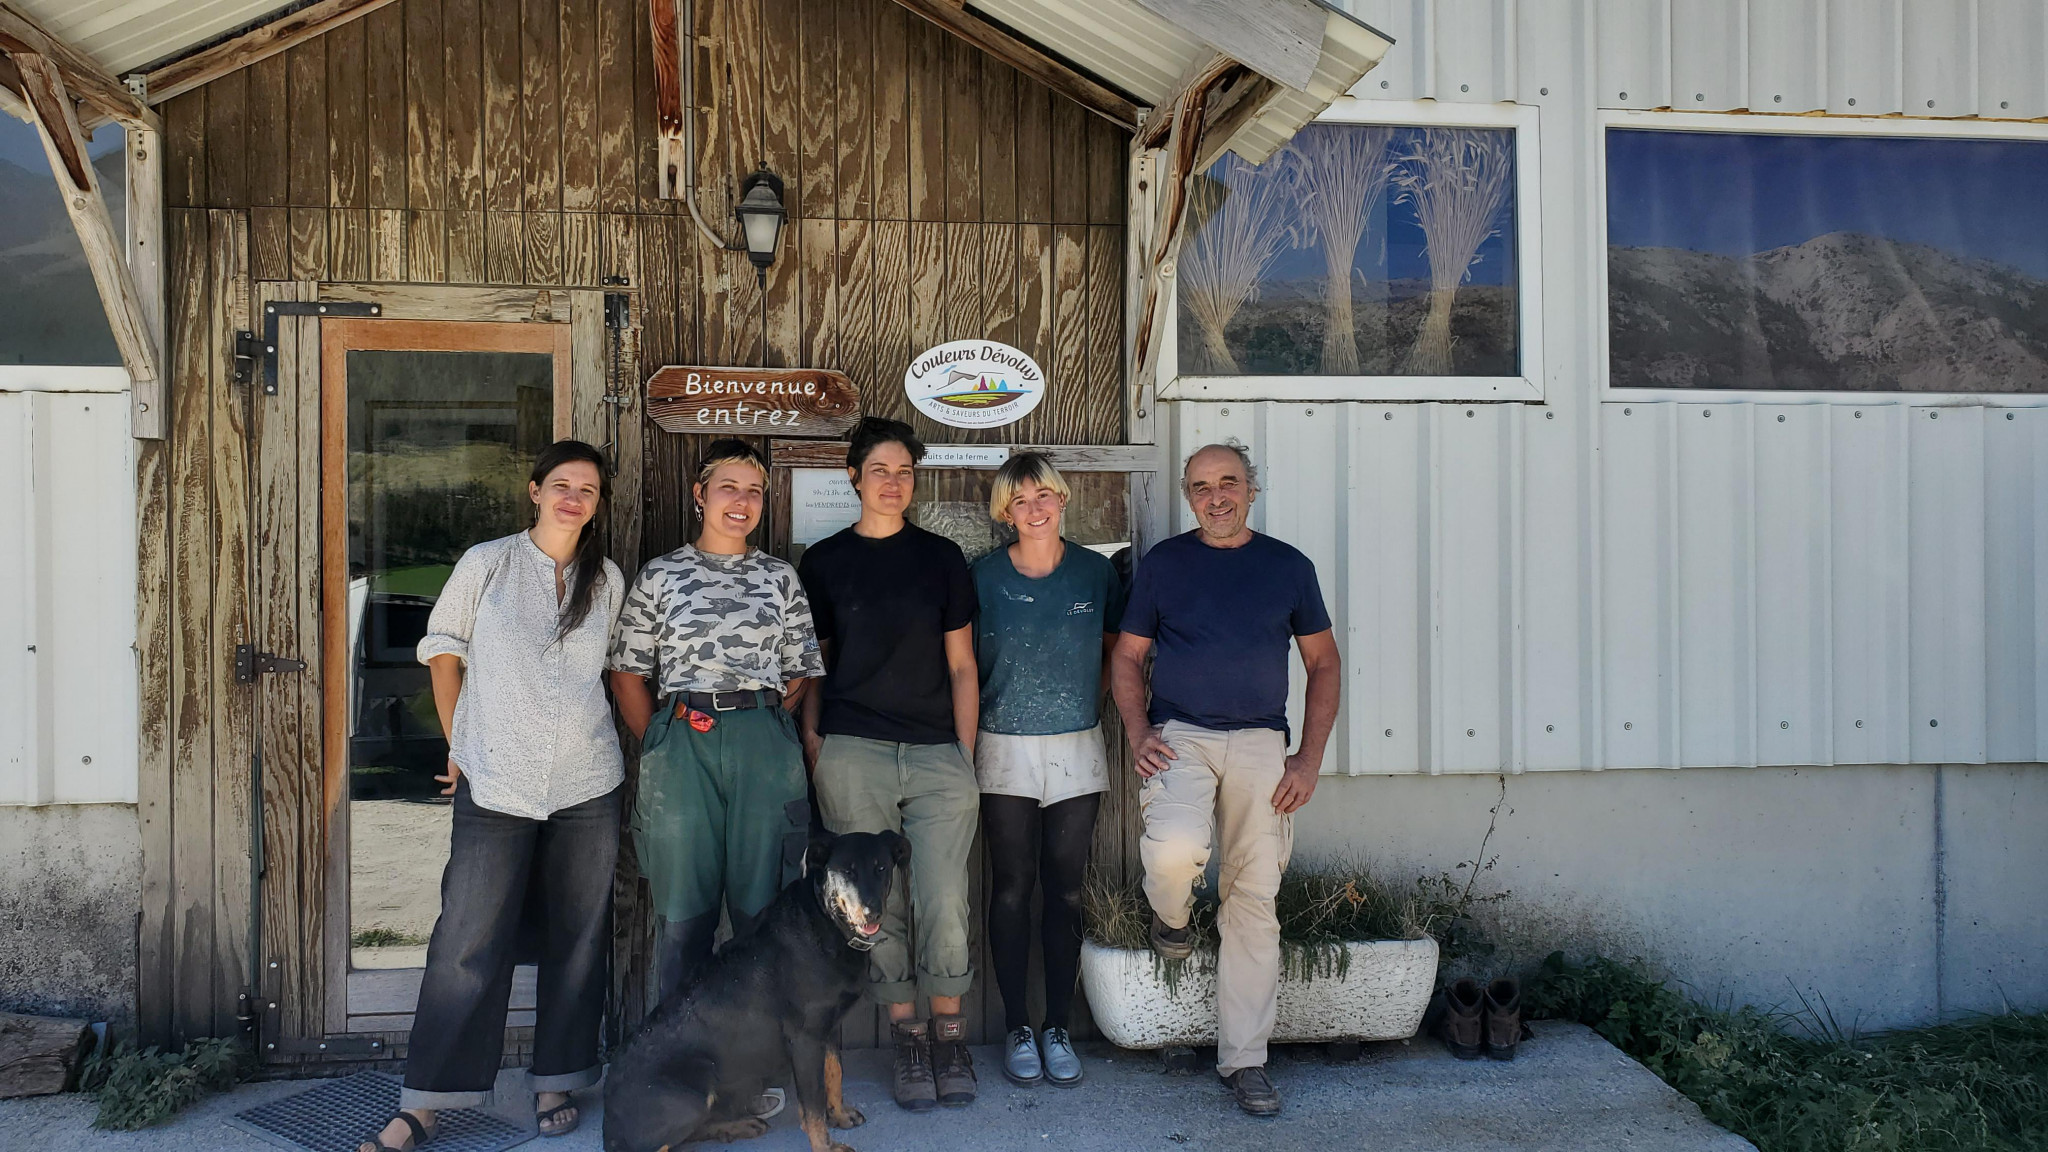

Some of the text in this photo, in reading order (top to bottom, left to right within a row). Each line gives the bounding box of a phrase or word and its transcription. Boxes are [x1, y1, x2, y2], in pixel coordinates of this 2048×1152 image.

[911, 345, 1039, 381] Couleurs Dévoluy
[685, 373, 827, 400] Bienvenue,
[696, 400, 801, 426] entrez
[928, 401, 944, 413] ARTS
[952, 409, 980, 418] SAVEURS
[994, 401, 1019, 416] TERROIR
[922, 452, 942, 460] duits
[965, 453, 989, 461] ferme
